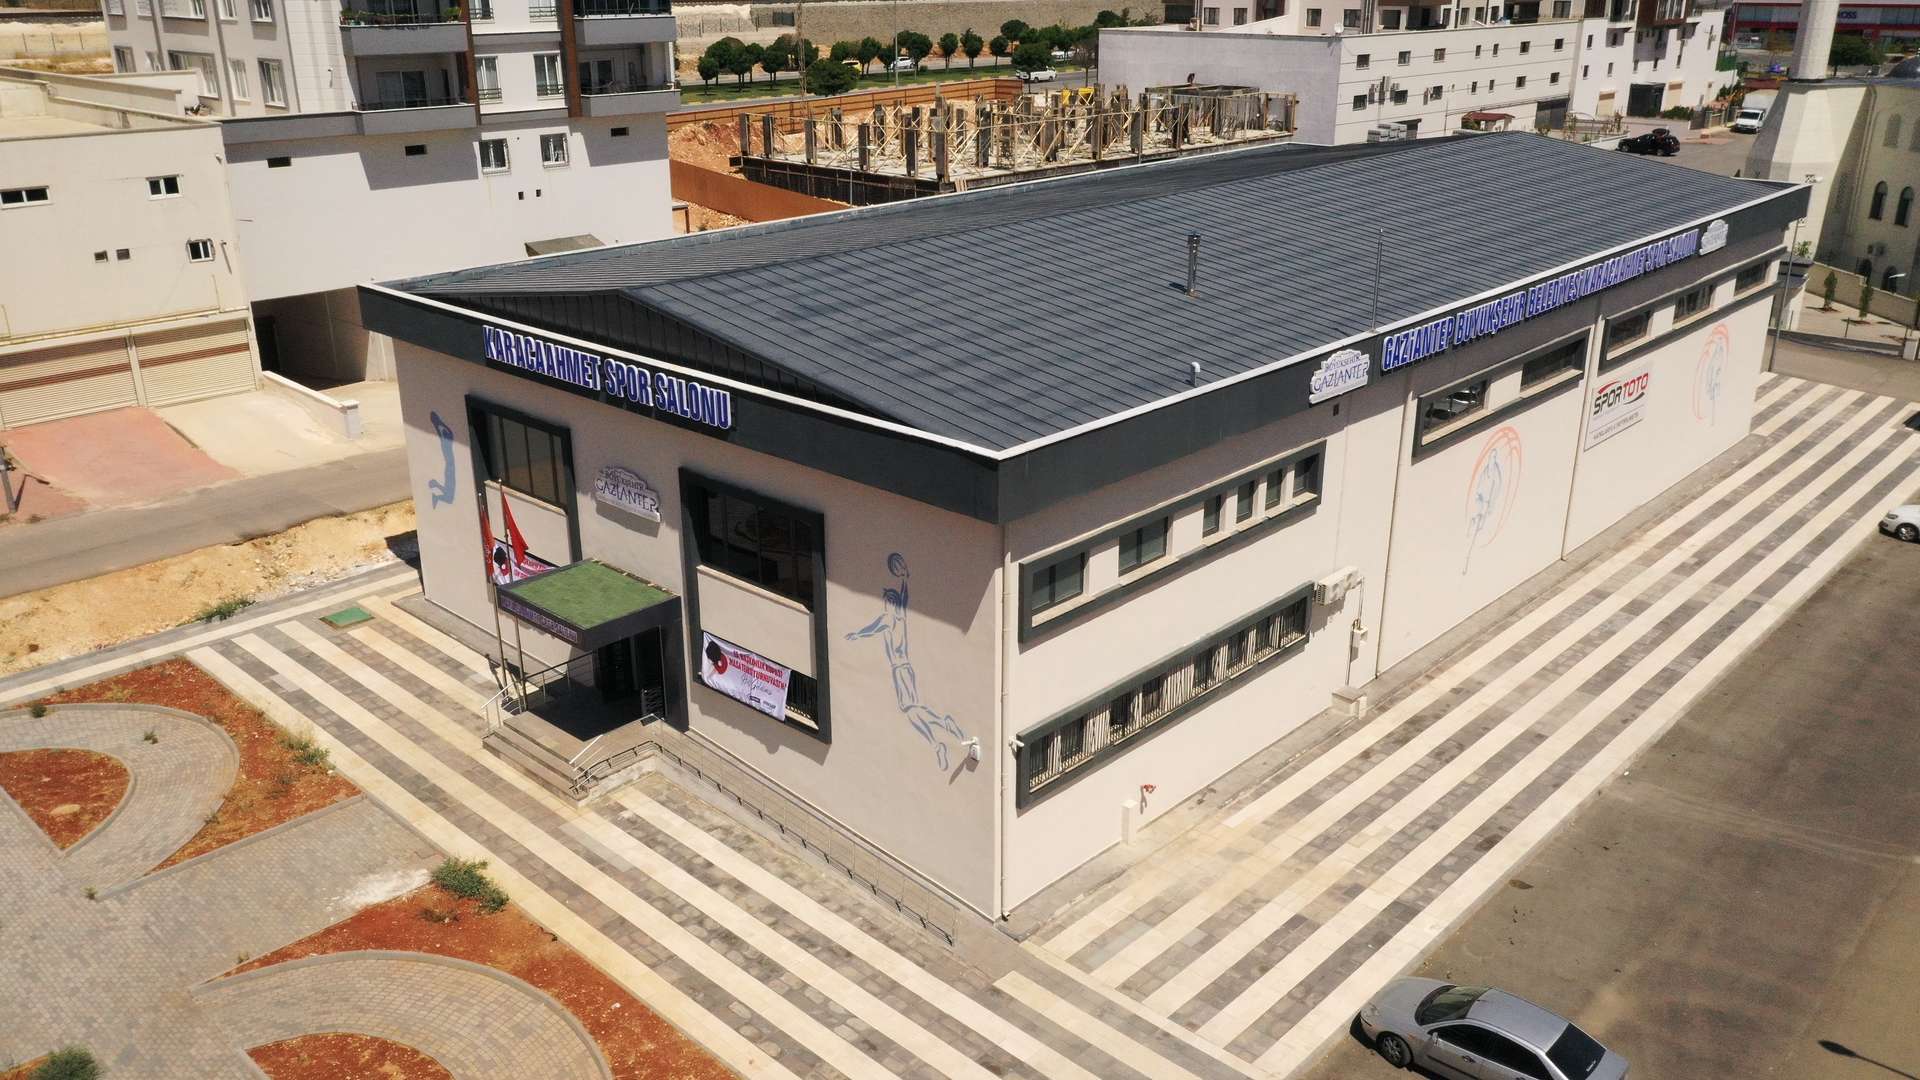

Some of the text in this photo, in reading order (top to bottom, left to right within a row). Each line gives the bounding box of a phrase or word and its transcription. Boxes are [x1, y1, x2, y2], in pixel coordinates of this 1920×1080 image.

[482, 325, 732, 429] KARACAAHMET SPOR SALONU
